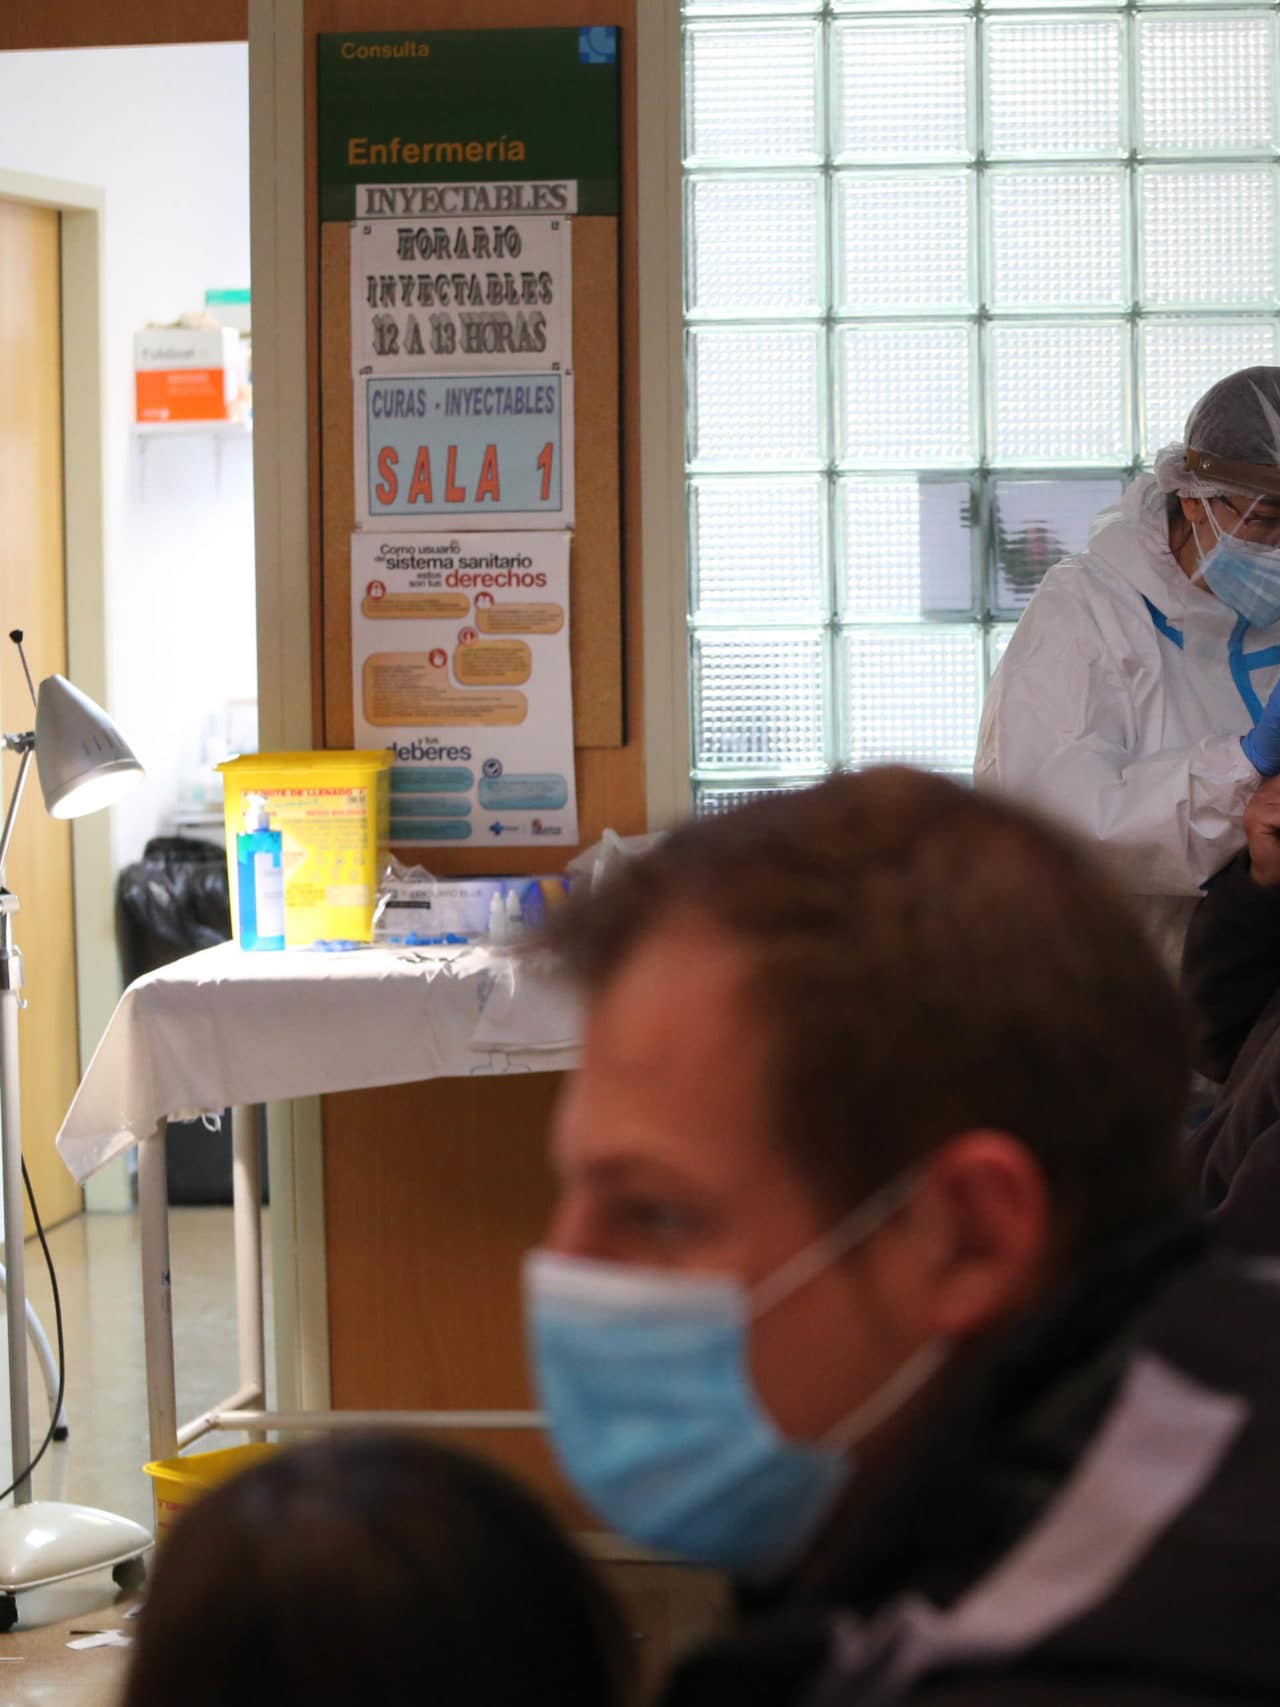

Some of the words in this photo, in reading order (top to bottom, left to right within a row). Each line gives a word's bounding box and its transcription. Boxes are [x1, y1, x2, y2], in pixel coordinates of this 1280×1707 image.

[341, 41, 430, 59] Consulta
[347, 135, 527, 166] Enfermería
[365, 184, 568, 215] INYECTABLES
[397, 225, 522, 260] HORARIO
[366, 271, 553, 308] INYECTABLES
[372, 314, 400, 356] 12
[404, 314, 426, 355] A
[430, 313, 457, 355] 13
[459, 311, 547, 354] HORAS
[372, 388, 427, 418] CURAS
[444, 385, 555, 416] INYECTABLES
[375, 443, 501, 506] SALA
[536, 441, 554, 501] 1
[380, 544, 416, 555] Como
[386, 555, 453, 570] sistema
[458, 552, 533, 570] sanitario
[445, 569, 547, 588] derechos
